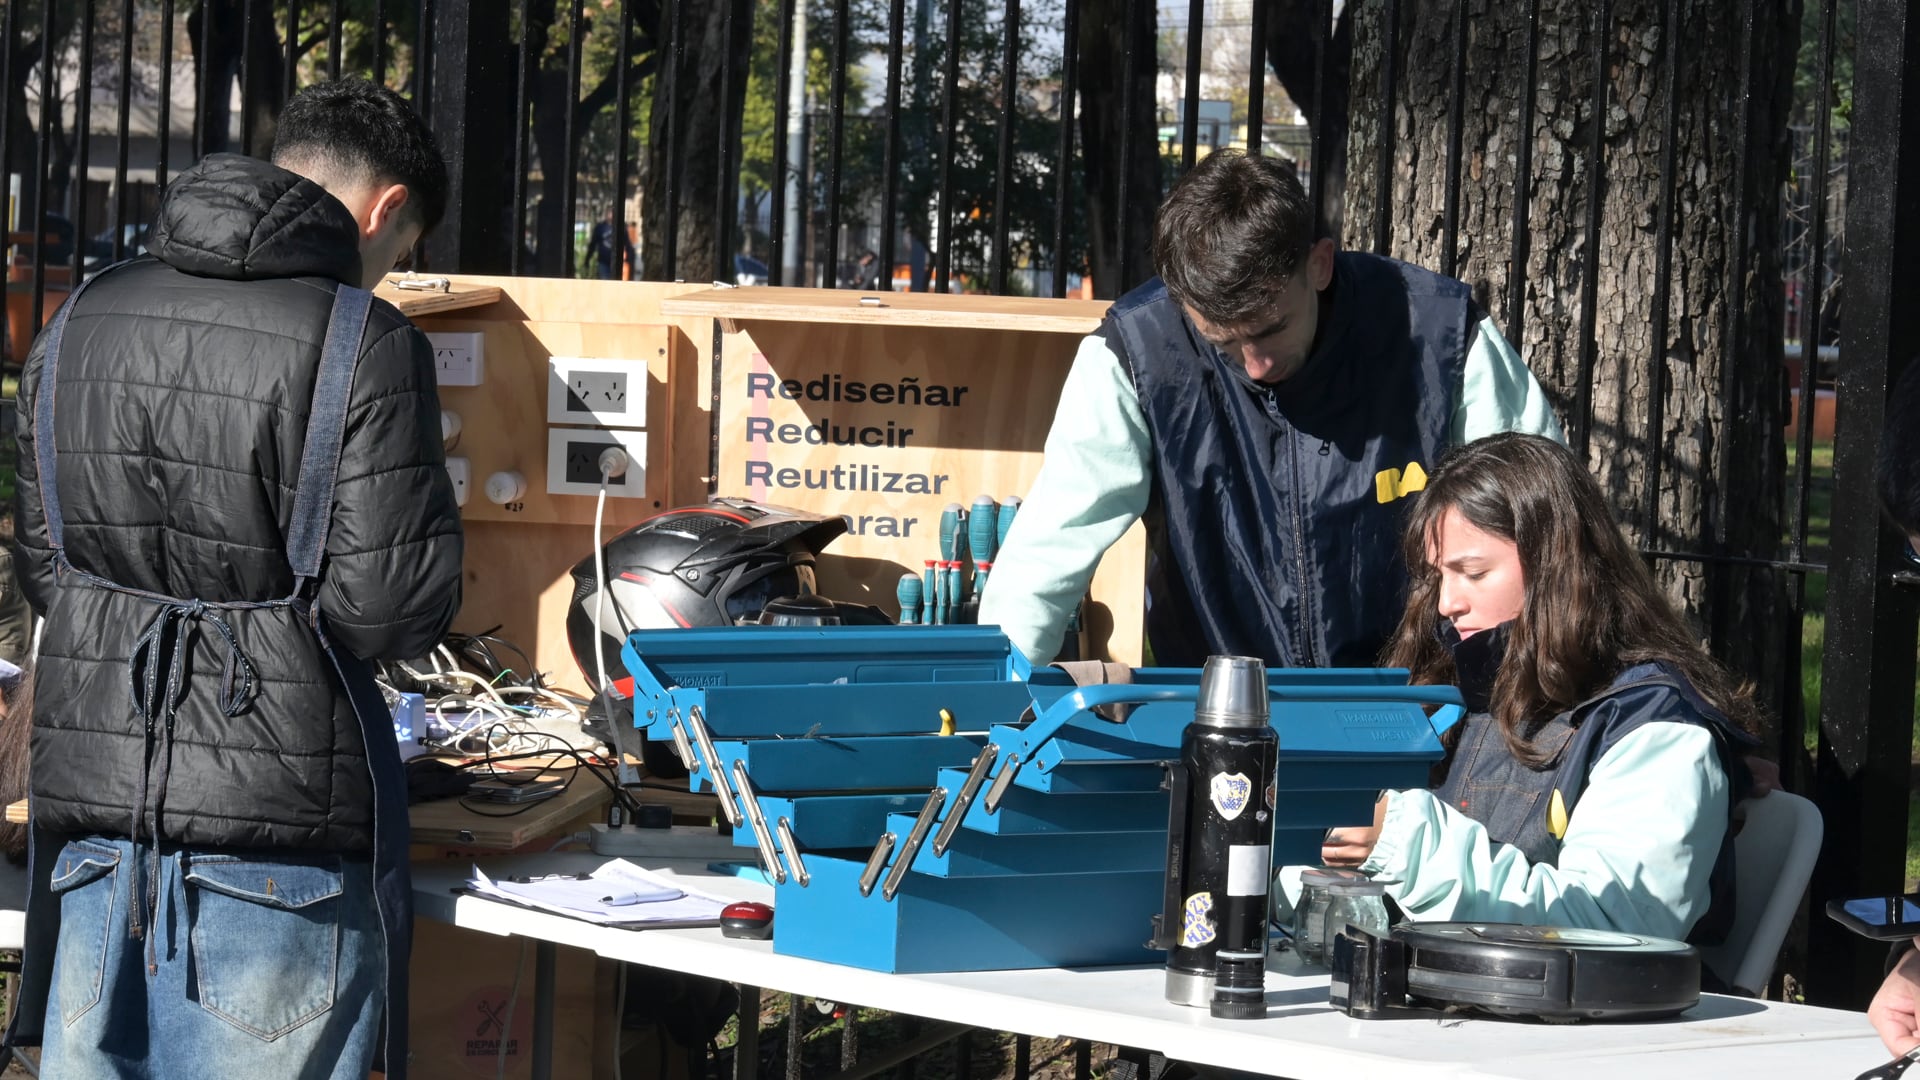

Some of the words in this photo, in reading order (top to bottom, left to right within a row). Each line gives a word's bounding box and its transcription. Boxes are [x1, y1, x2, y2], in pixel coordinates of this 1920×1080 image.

[747, 372, 969, 407] Rediseñar
[746, 416, 914, 449] Reducir
[744, 460, 950, 495] Reutilizar
[841, 514, 918, 538] arar
